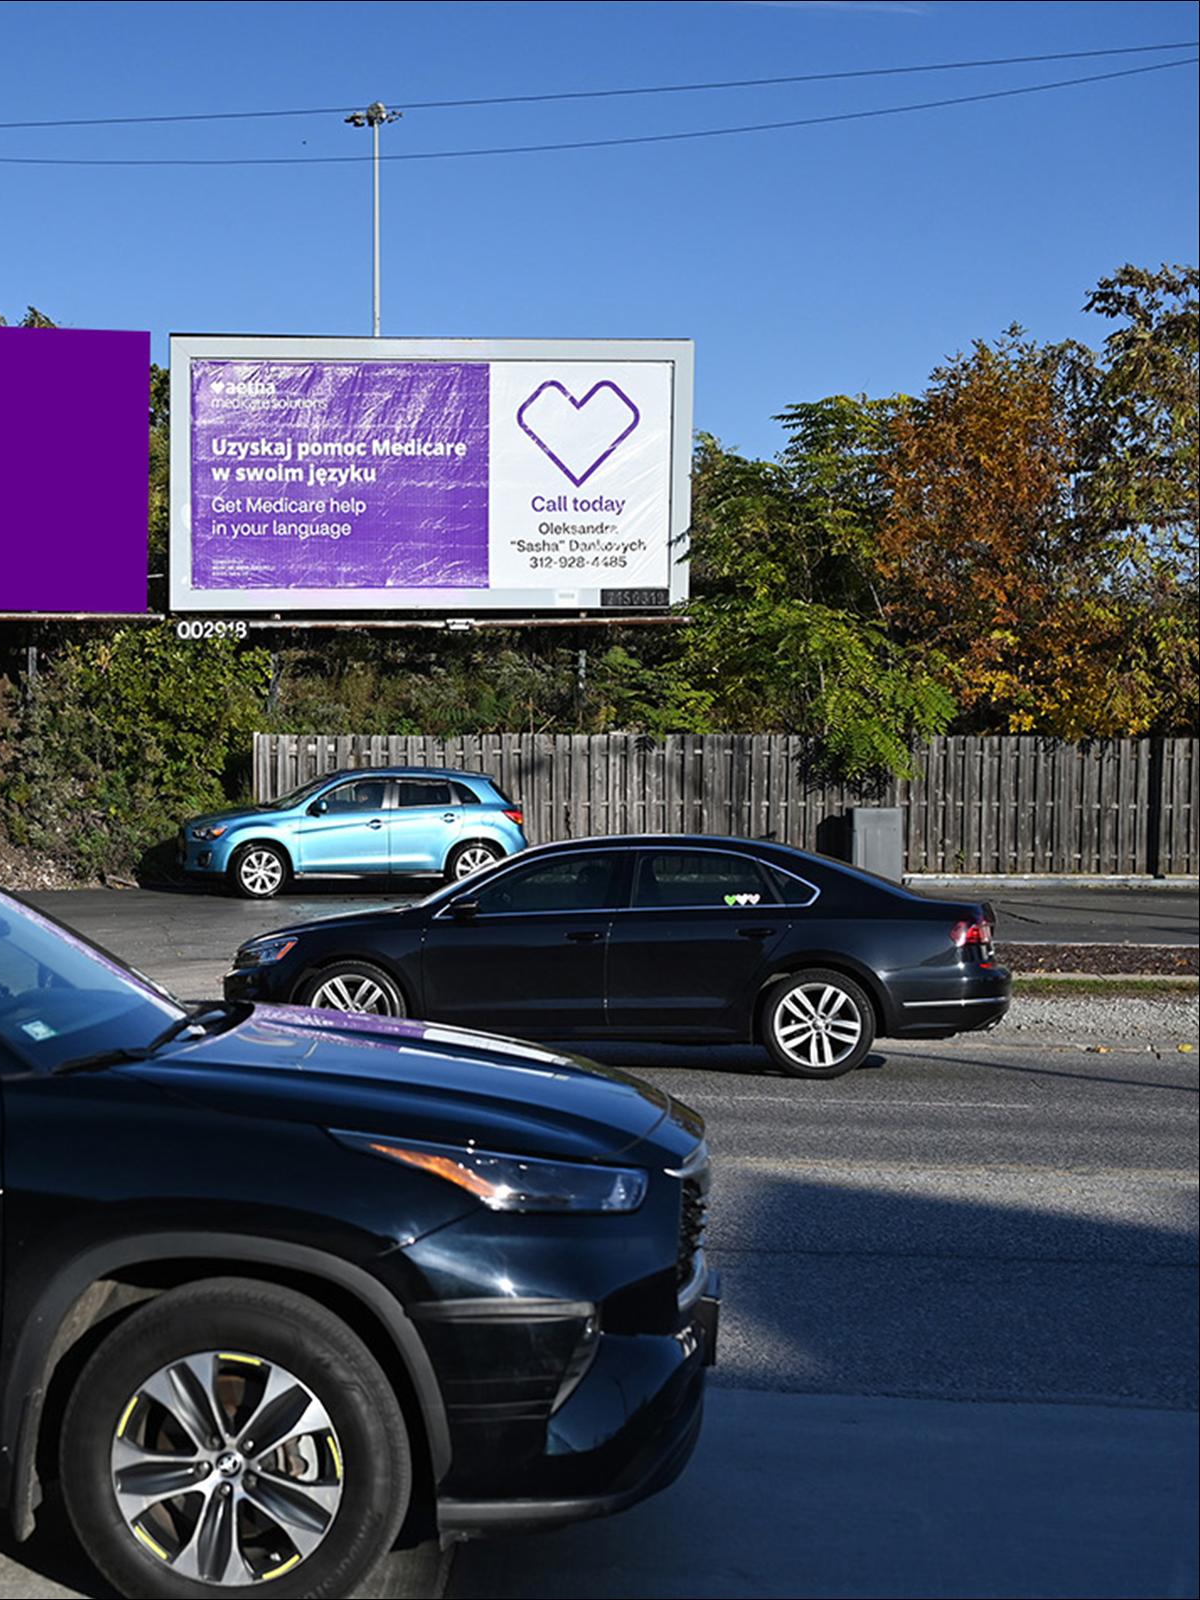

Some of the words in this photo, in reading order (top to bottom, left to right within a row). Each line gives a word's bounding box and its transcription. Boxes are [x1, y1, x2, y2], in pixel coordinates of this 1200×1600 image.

[225, 380, 276, 395] aetna
[212, 438, 292, 460] Uzyskaj
[298, 442, 367, 460] pomoc
[372, 438, 467, 456] Medicare
[212, 466, 230, 481] w
[235, 464, 303, 482] swoim
[307, 464, 376, 487] języku
[212, 498, 242, 513] Get
[246, 498, 325, 513] Medicare
[330, 498, 366, 515] help
[531, 495, 568, 512] Call
[573, 495, 626, 516] today
[212, 520, 227, 535] in
[231, 524, 269, 539] your
[273, 520, 351, 539] language
[529, 556, 628, 569] 312-928-4485
[177, 621, 247, 639] 002918
